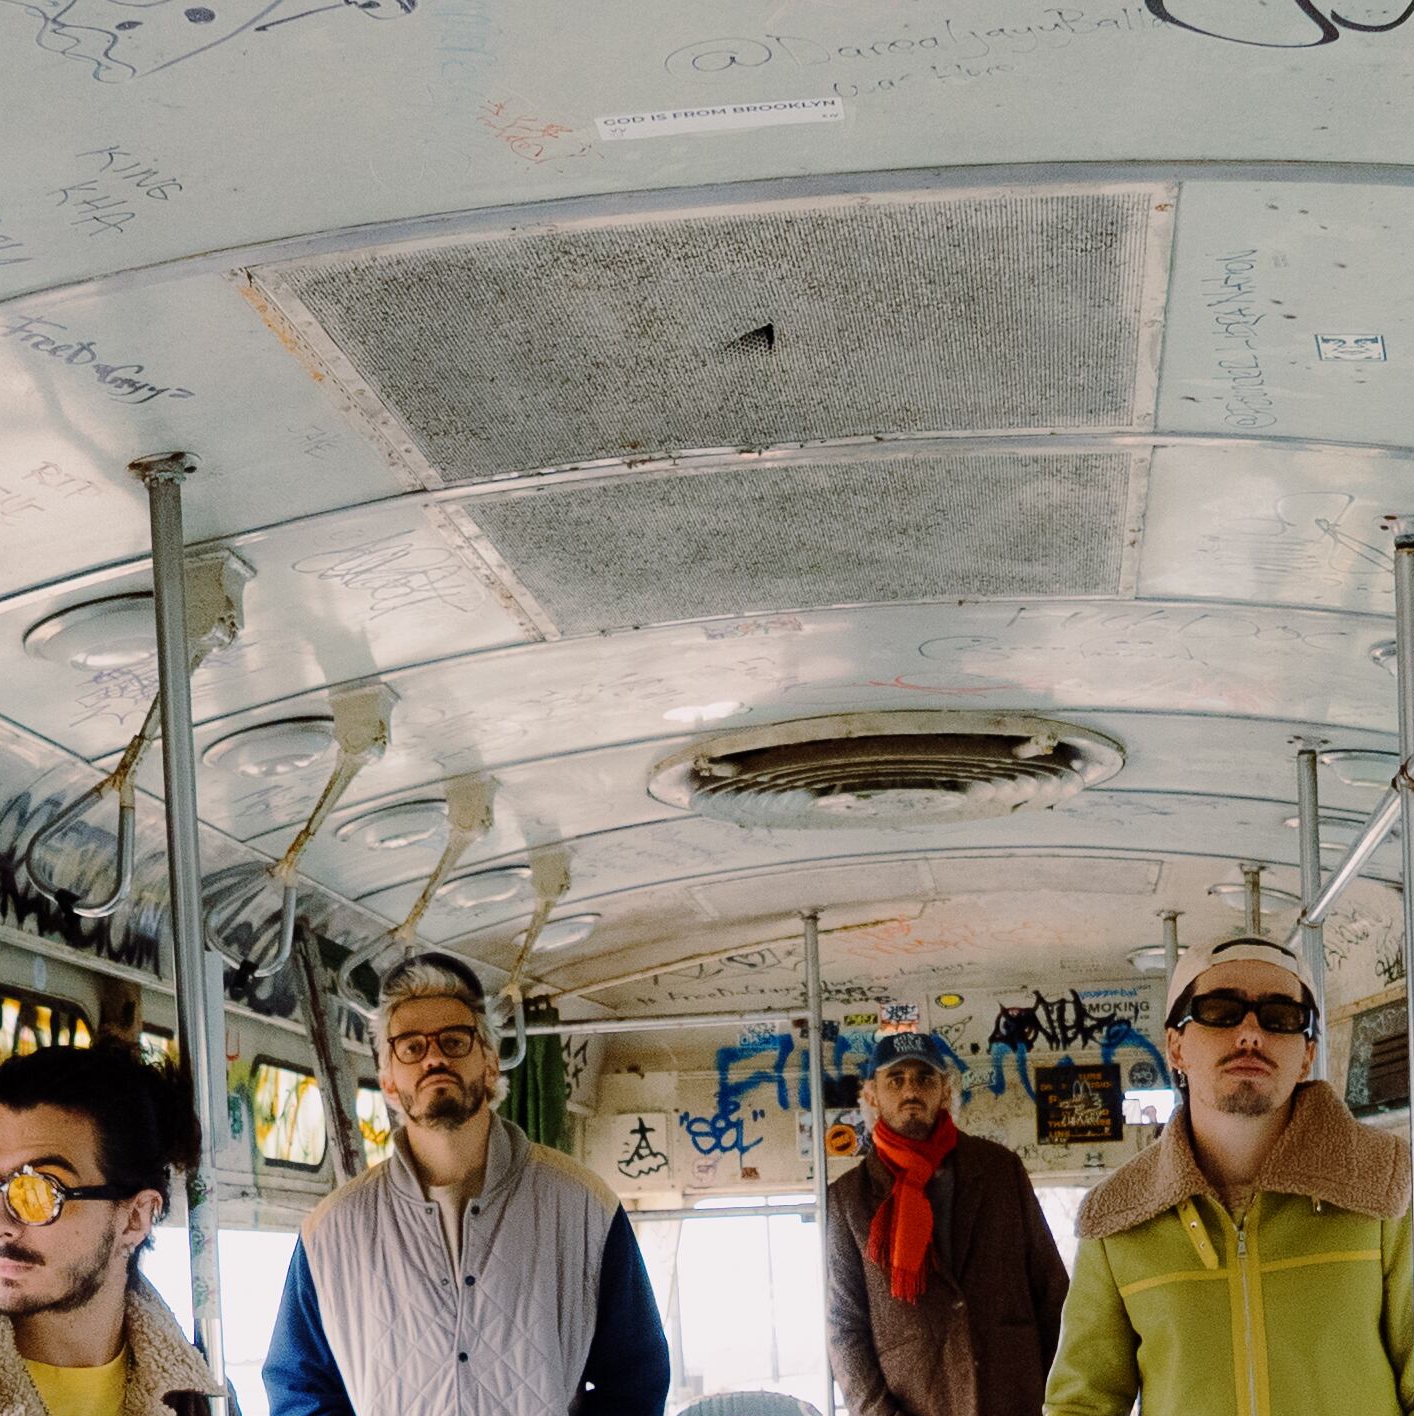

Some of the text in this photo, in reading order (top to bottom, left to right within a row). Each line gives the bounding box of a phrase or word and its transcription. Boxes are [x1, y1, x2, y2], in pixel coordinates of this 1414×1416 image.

[603, 99, 836, 127] GOD IS FROM BROOKLYN
[76, 143, 184, 201] KING
